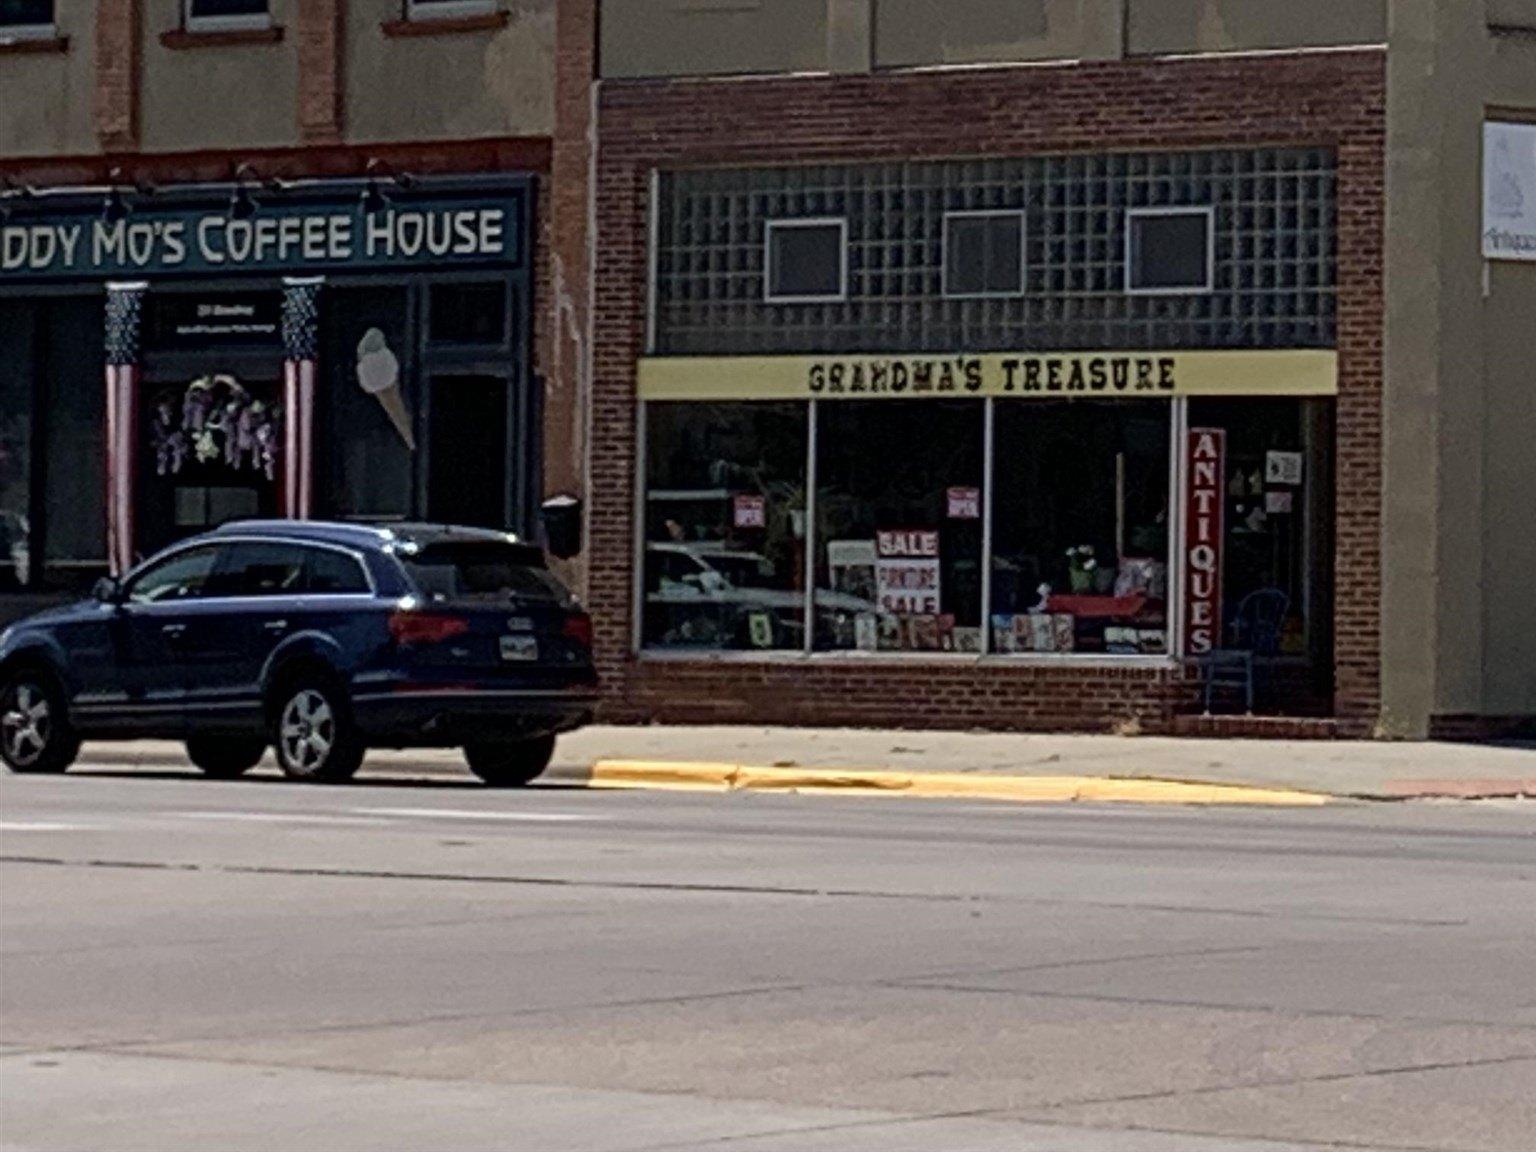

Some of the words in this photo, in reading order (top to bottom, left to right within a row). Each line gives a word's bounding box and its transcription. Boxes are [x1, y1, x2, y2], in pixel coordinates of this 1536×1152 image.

[808, 356, 983, 393] GRANDMA'S
[1001, 357, 1176, 392] TREASURE
[878, 531, 938, 556] SALE
[1190, 433, 1218, 654] ANTIQUES
